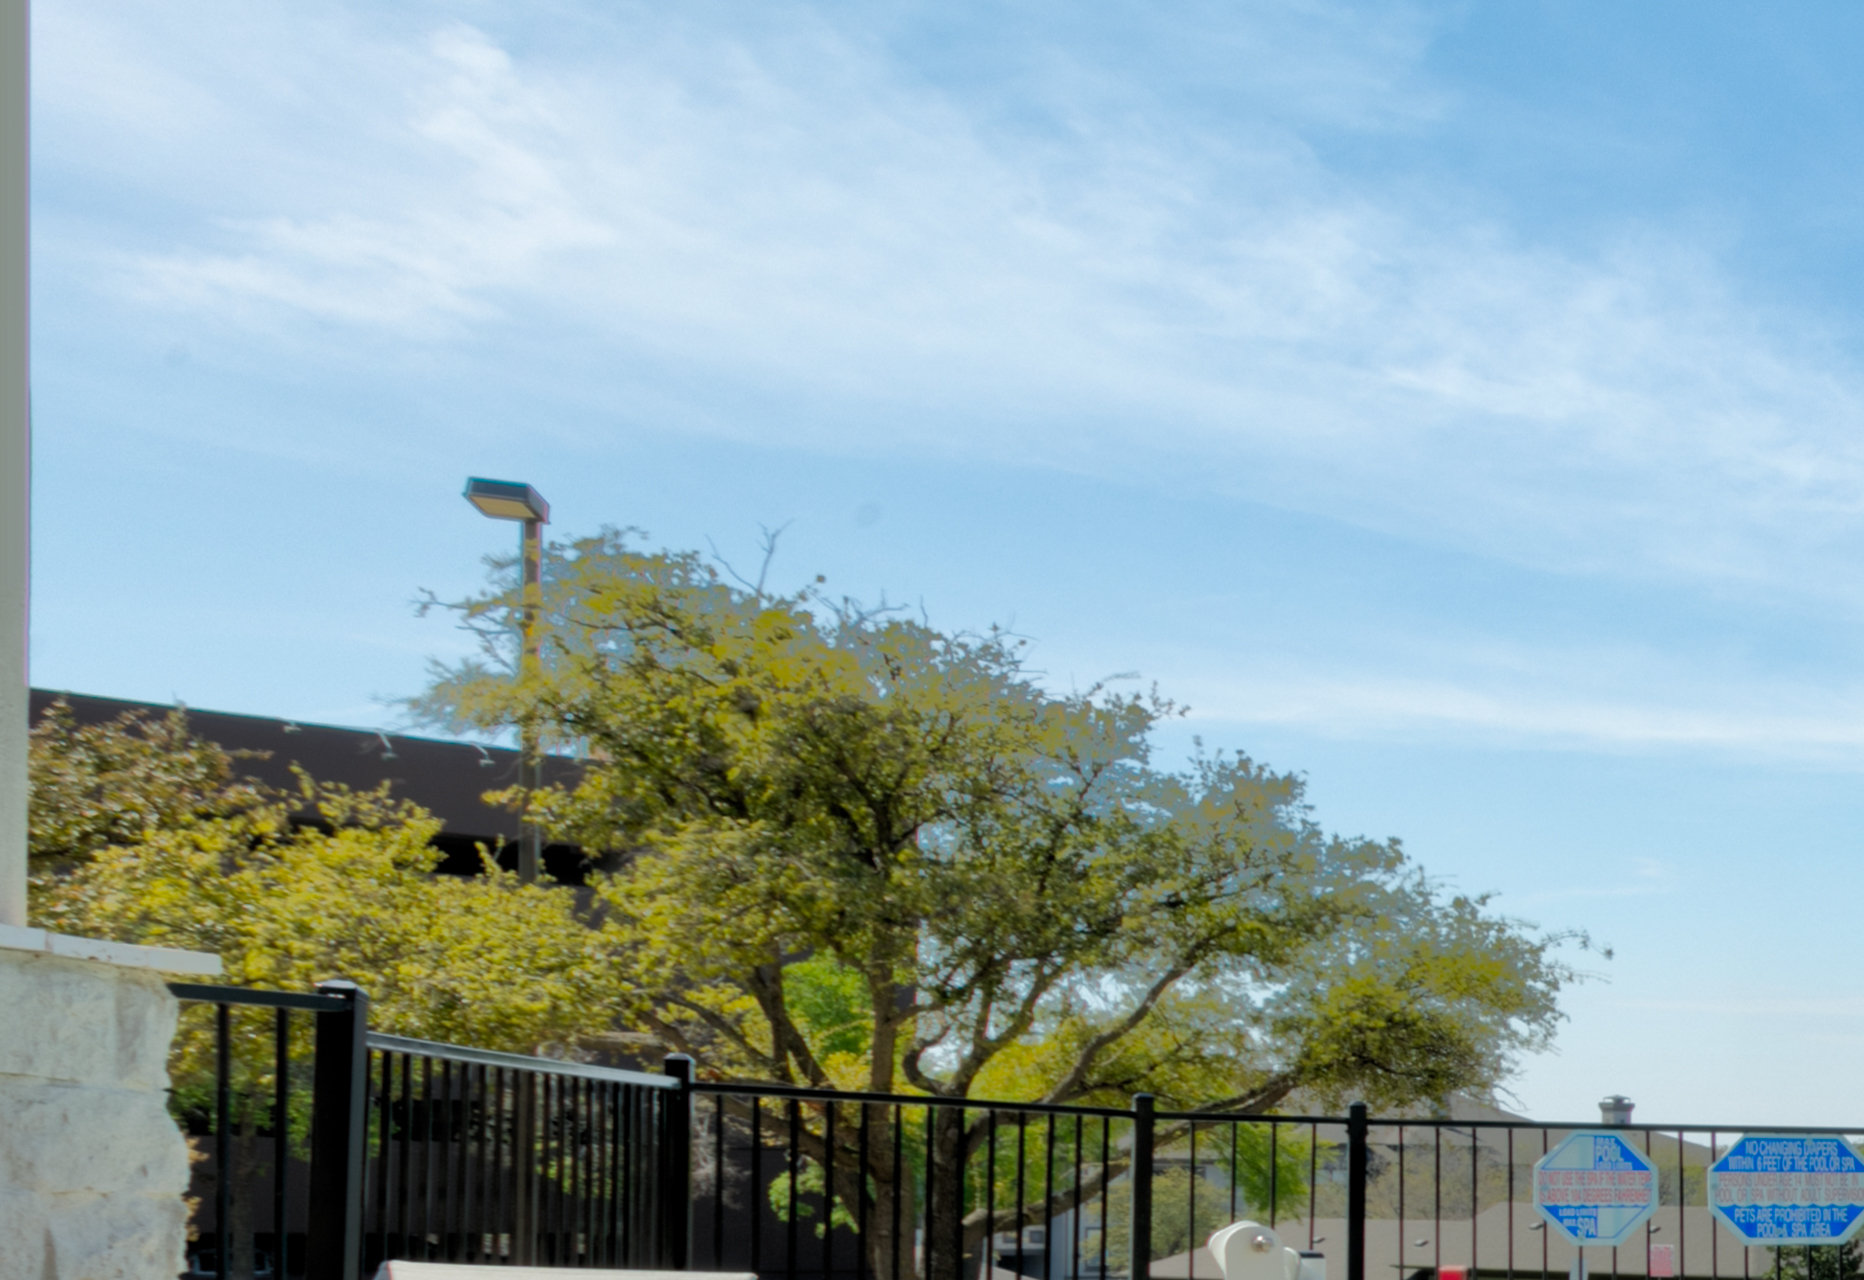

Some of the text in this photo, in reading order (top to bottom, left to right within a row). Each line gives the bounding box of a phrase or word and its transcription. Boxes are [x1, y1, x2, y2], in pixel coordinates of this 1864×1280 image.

[1746, 1141, 1758, 1155] NO
[1759, 1141, 1802, 1155] CHANGING
[1728, 1156, 1855, 1171] WITHIN 6 FEET OF THE POOL OR SPA
[1734, 1208, 1848, 1223] PETS ARE PROHIBITED IN THE
[1792, 1224, 1807, 1238] SPA
[1810, 1224, 1831, 1238] AREA
